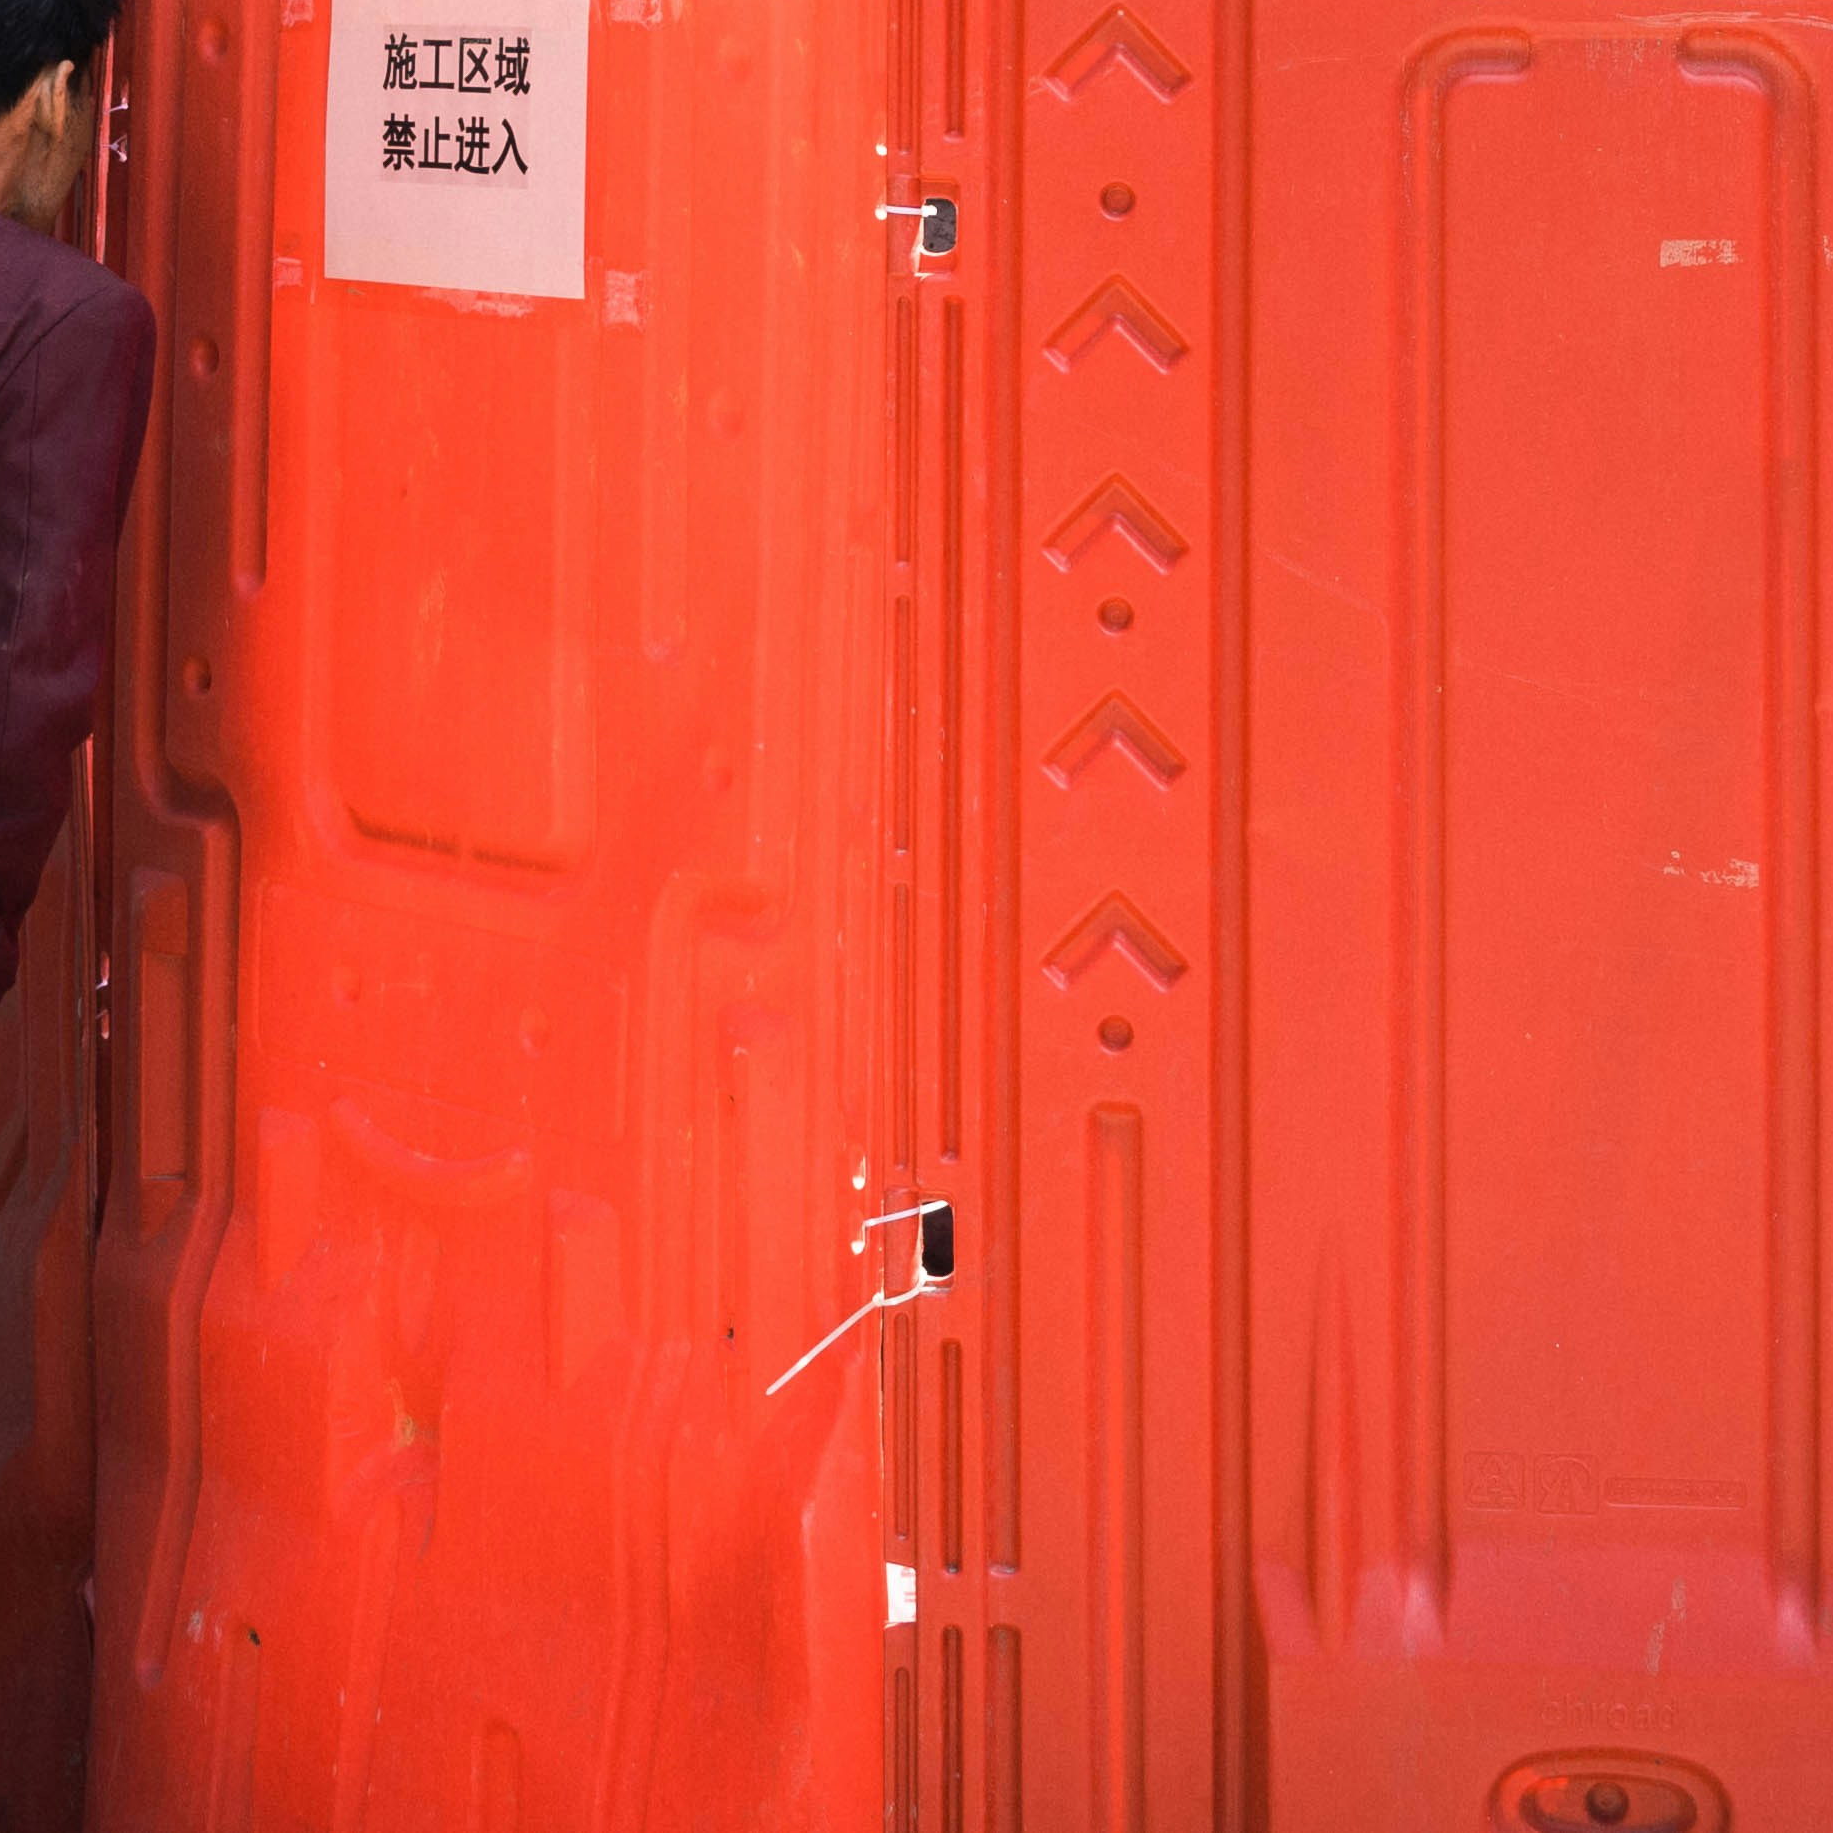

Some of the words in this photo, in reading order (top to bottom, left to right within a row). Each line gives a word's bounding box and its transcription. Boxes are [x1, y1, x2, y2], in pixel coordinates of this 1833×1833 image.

[382, 33, 531, 95] 施工区域
[382, 112, 529, 175] 禁止进入
